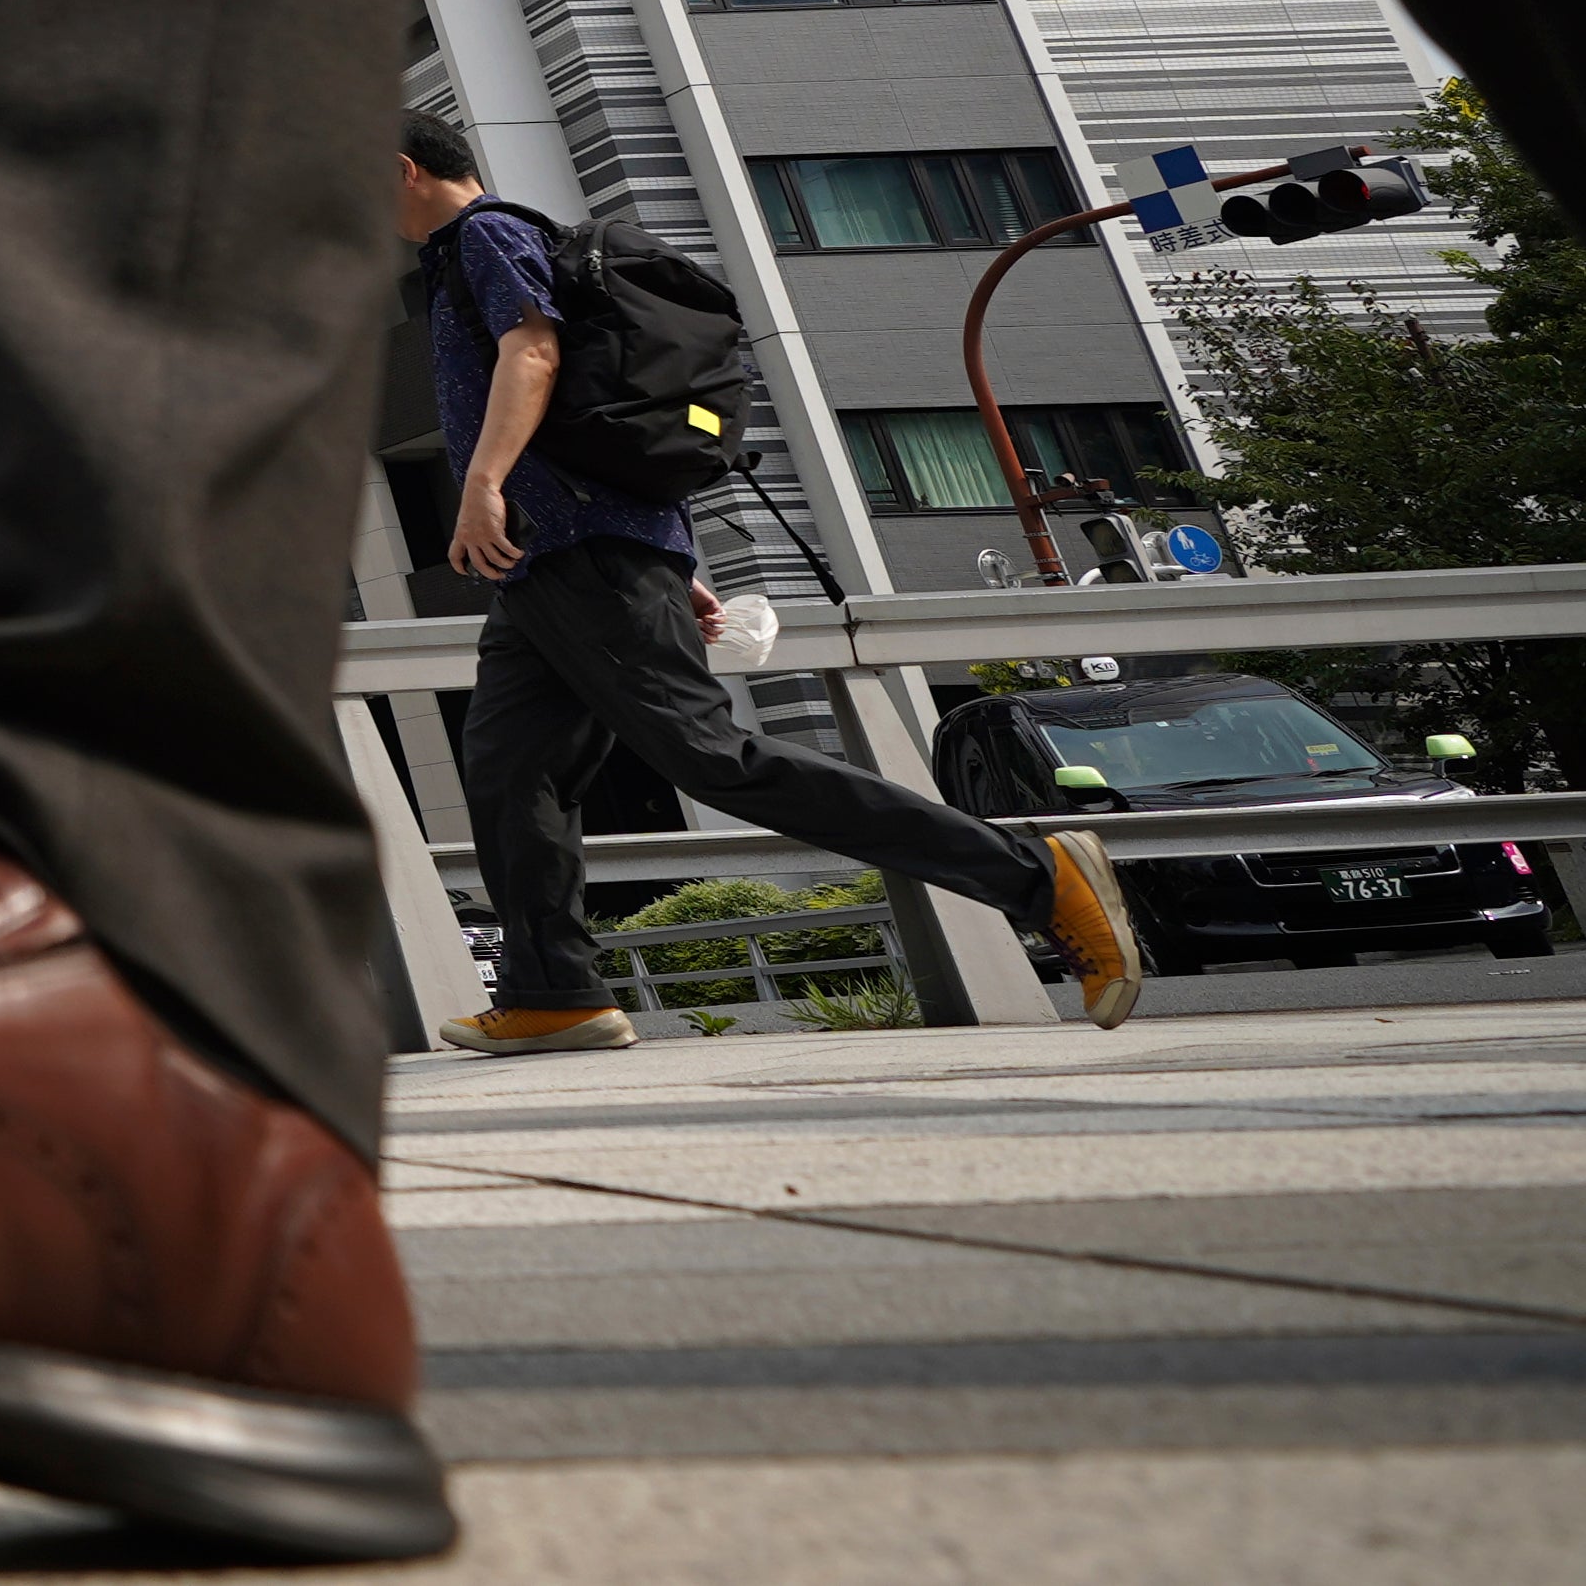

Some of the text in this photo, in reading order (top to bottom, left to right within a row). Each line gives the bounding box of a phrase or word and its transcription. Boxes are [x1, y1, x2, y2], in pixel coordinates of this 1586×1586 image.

[1149, 218, 1234, 252] 時差式
[1341, 878, 1403, 900] 76-37
